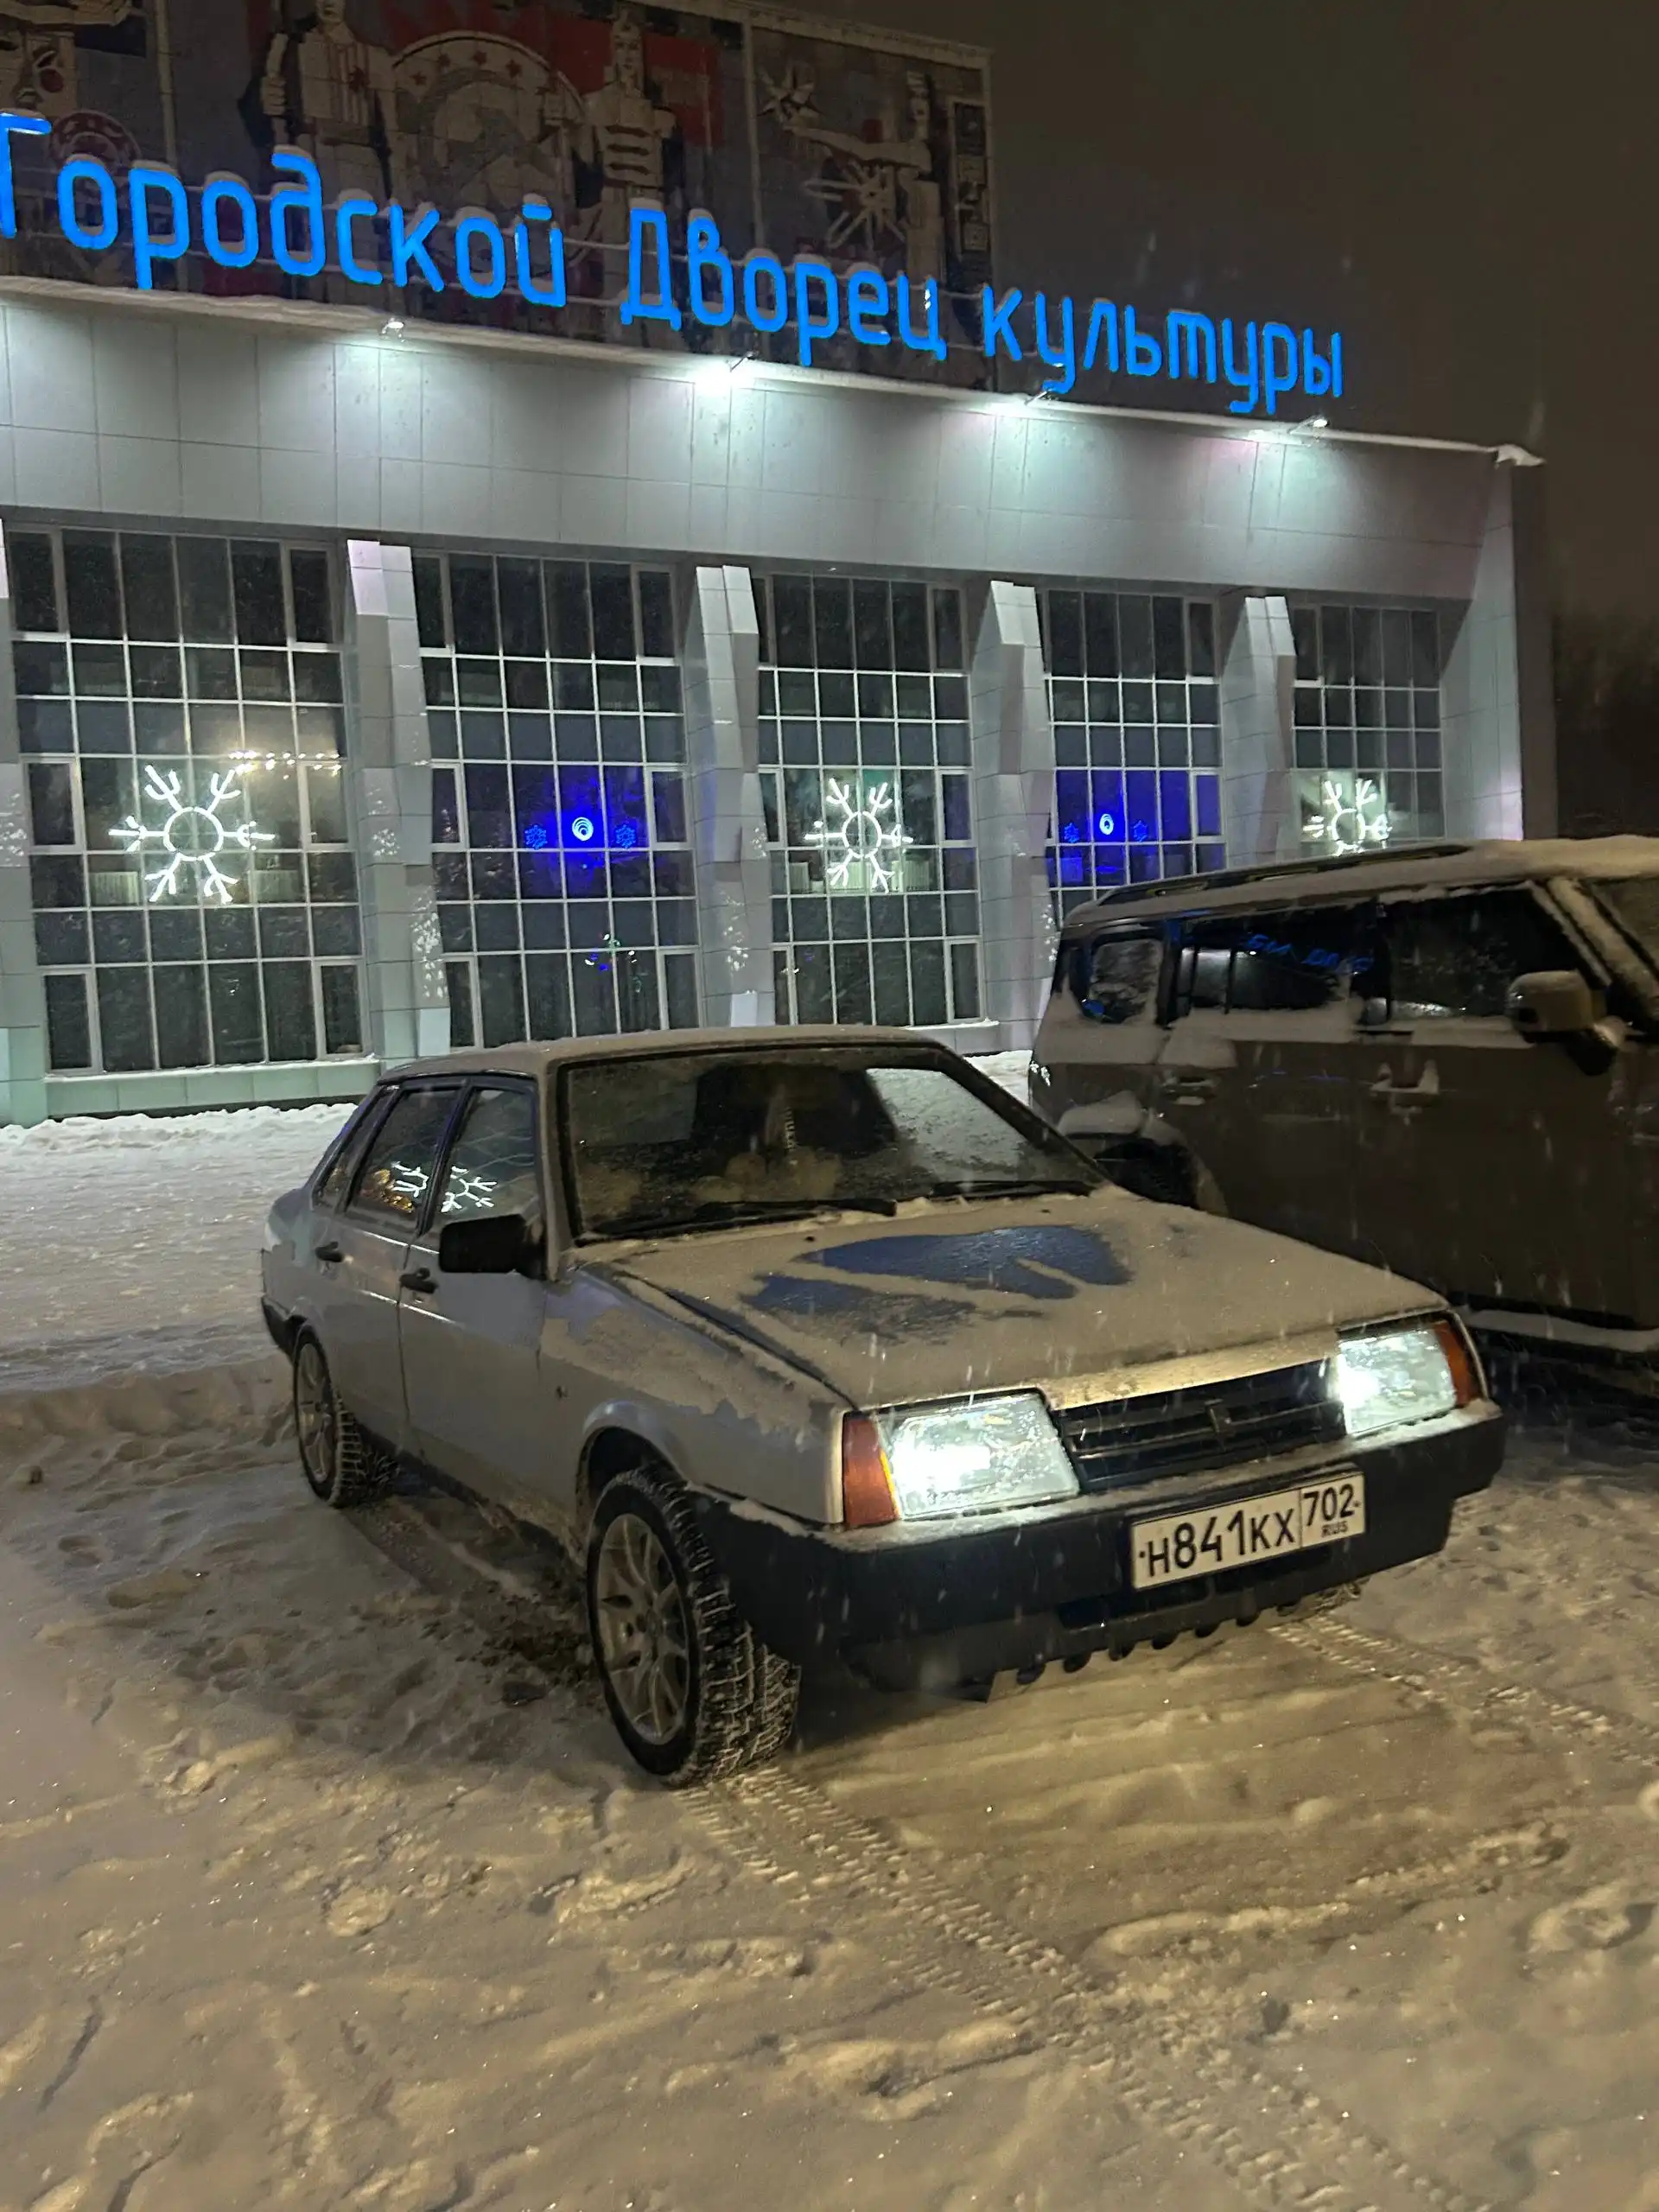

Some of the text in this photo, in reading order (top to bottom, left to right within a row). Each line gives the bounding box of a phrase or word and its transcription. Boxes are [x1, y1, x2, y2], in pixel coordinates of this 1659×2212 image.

[0, 113, 1343, 415] Городской Дворец культуры
